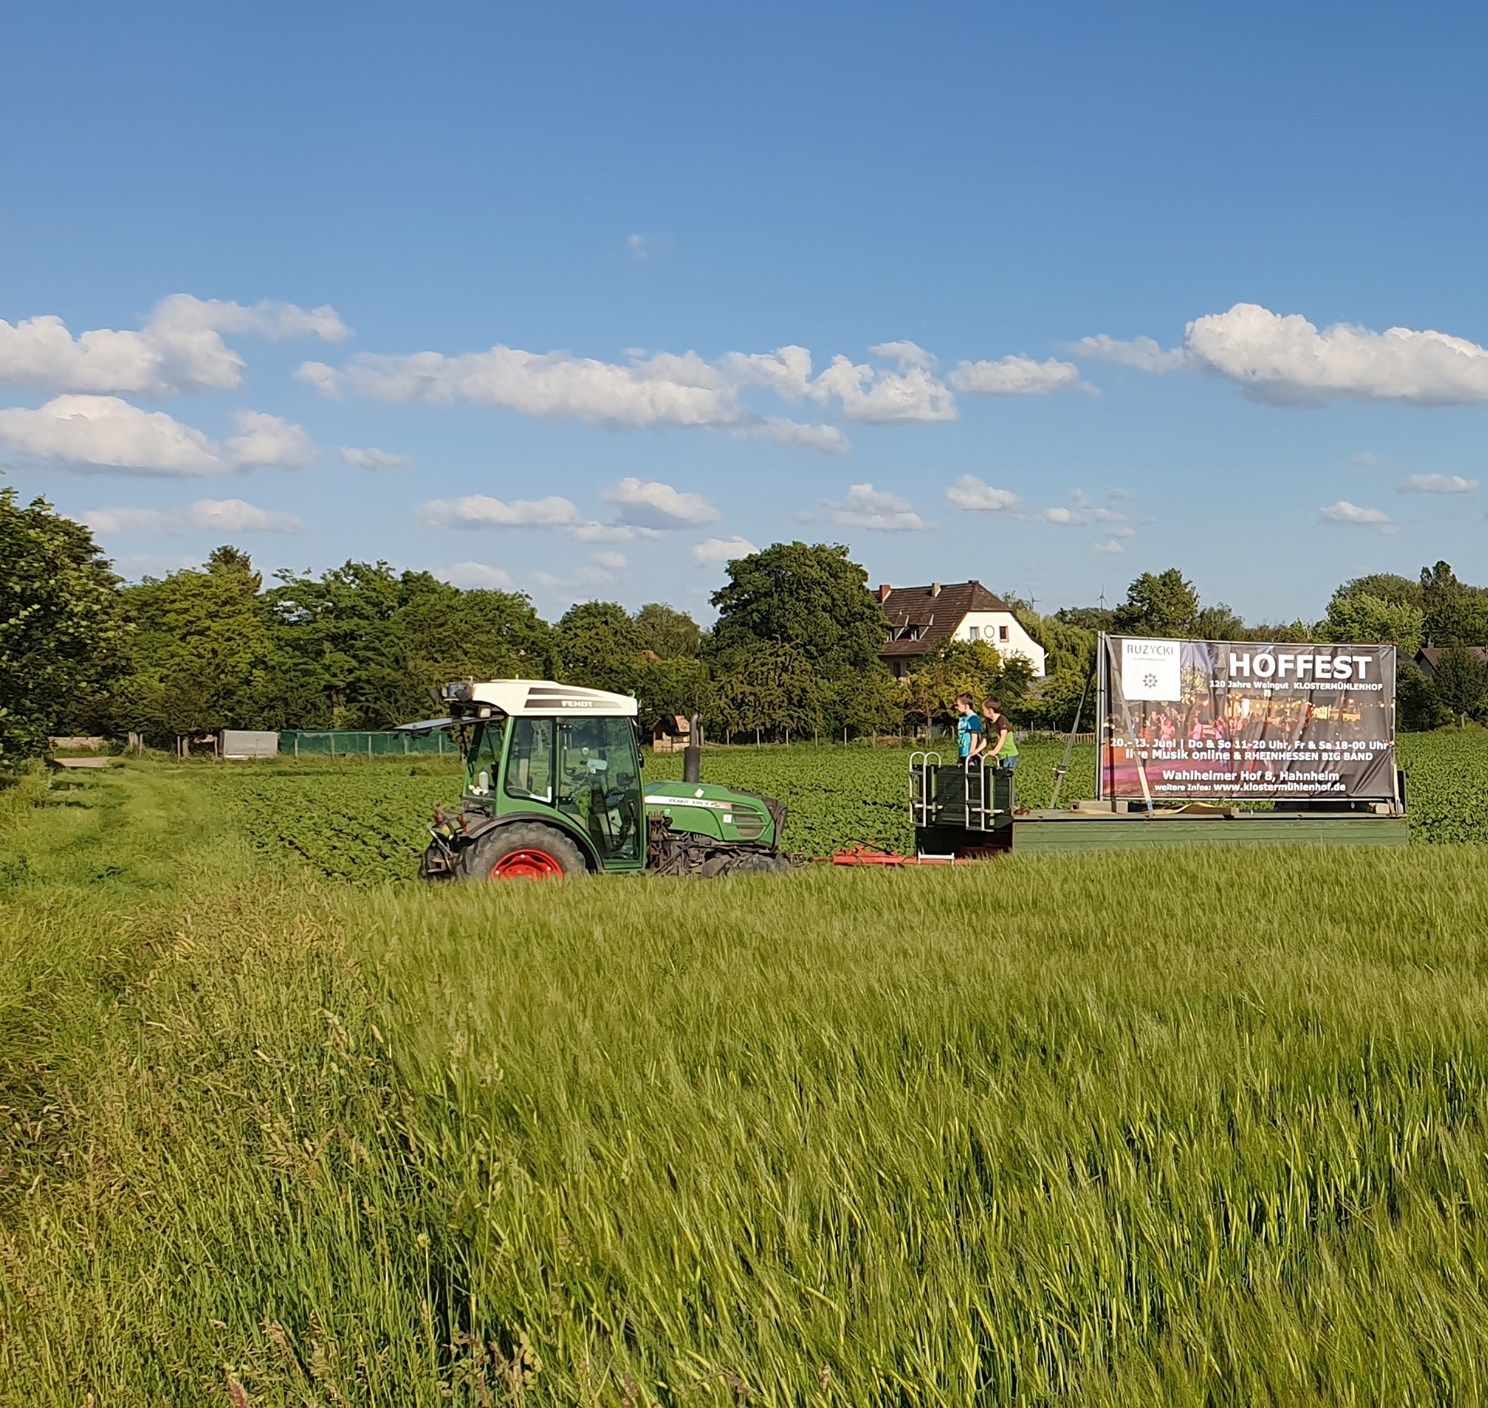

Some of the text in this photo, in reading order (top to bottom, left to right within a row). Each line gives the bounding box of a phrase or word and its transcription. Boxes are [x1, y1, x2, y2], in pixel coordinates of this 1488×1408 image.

[1127, 644, 1174, 655] RUZYCKI
[1229, 652, 1373, 679] HOFFEST
[1209, 680, 1226, 688] 120
[1254, 681, 1289, 691] Weingut
[1293, 681, 1383, 691] KLOSTERMÜHLENHOF
[1153, 738, 1177, 748] Juni
[1188, 739, 1203, 748] Do
[1206, 739, 1215, 748] &
[1217, 739, 1231, 749] So
[1234, 740, 1266, 749] 11-20
[1269, 740, 1291, 750] Uhr,
[1294, 740, 1305, 749] Fr
[1308, 740, 1316, 750] &
[1319, 740, 1331, 750] Sa
[1335, 741, 1365, 750] 18-00
[1369, 741, 1389, 750] Uhr
[1152, 749, 1188, 759] Musik
[1192, 749, 1230, 760] online
[1233, 751, 1242, 760] &
[1244, 752, 1318, 760] RHEINHESSEN
[1321, 752, 1341, 760] BIG
[1344, 752, 1373, 761] BAND
[1163, 770, 1340, 782] Wahlheimer Hof 8, Hahnheim
[1154, 782, 1346, 791] weitere Infos: www.klostermühlenhof.de
